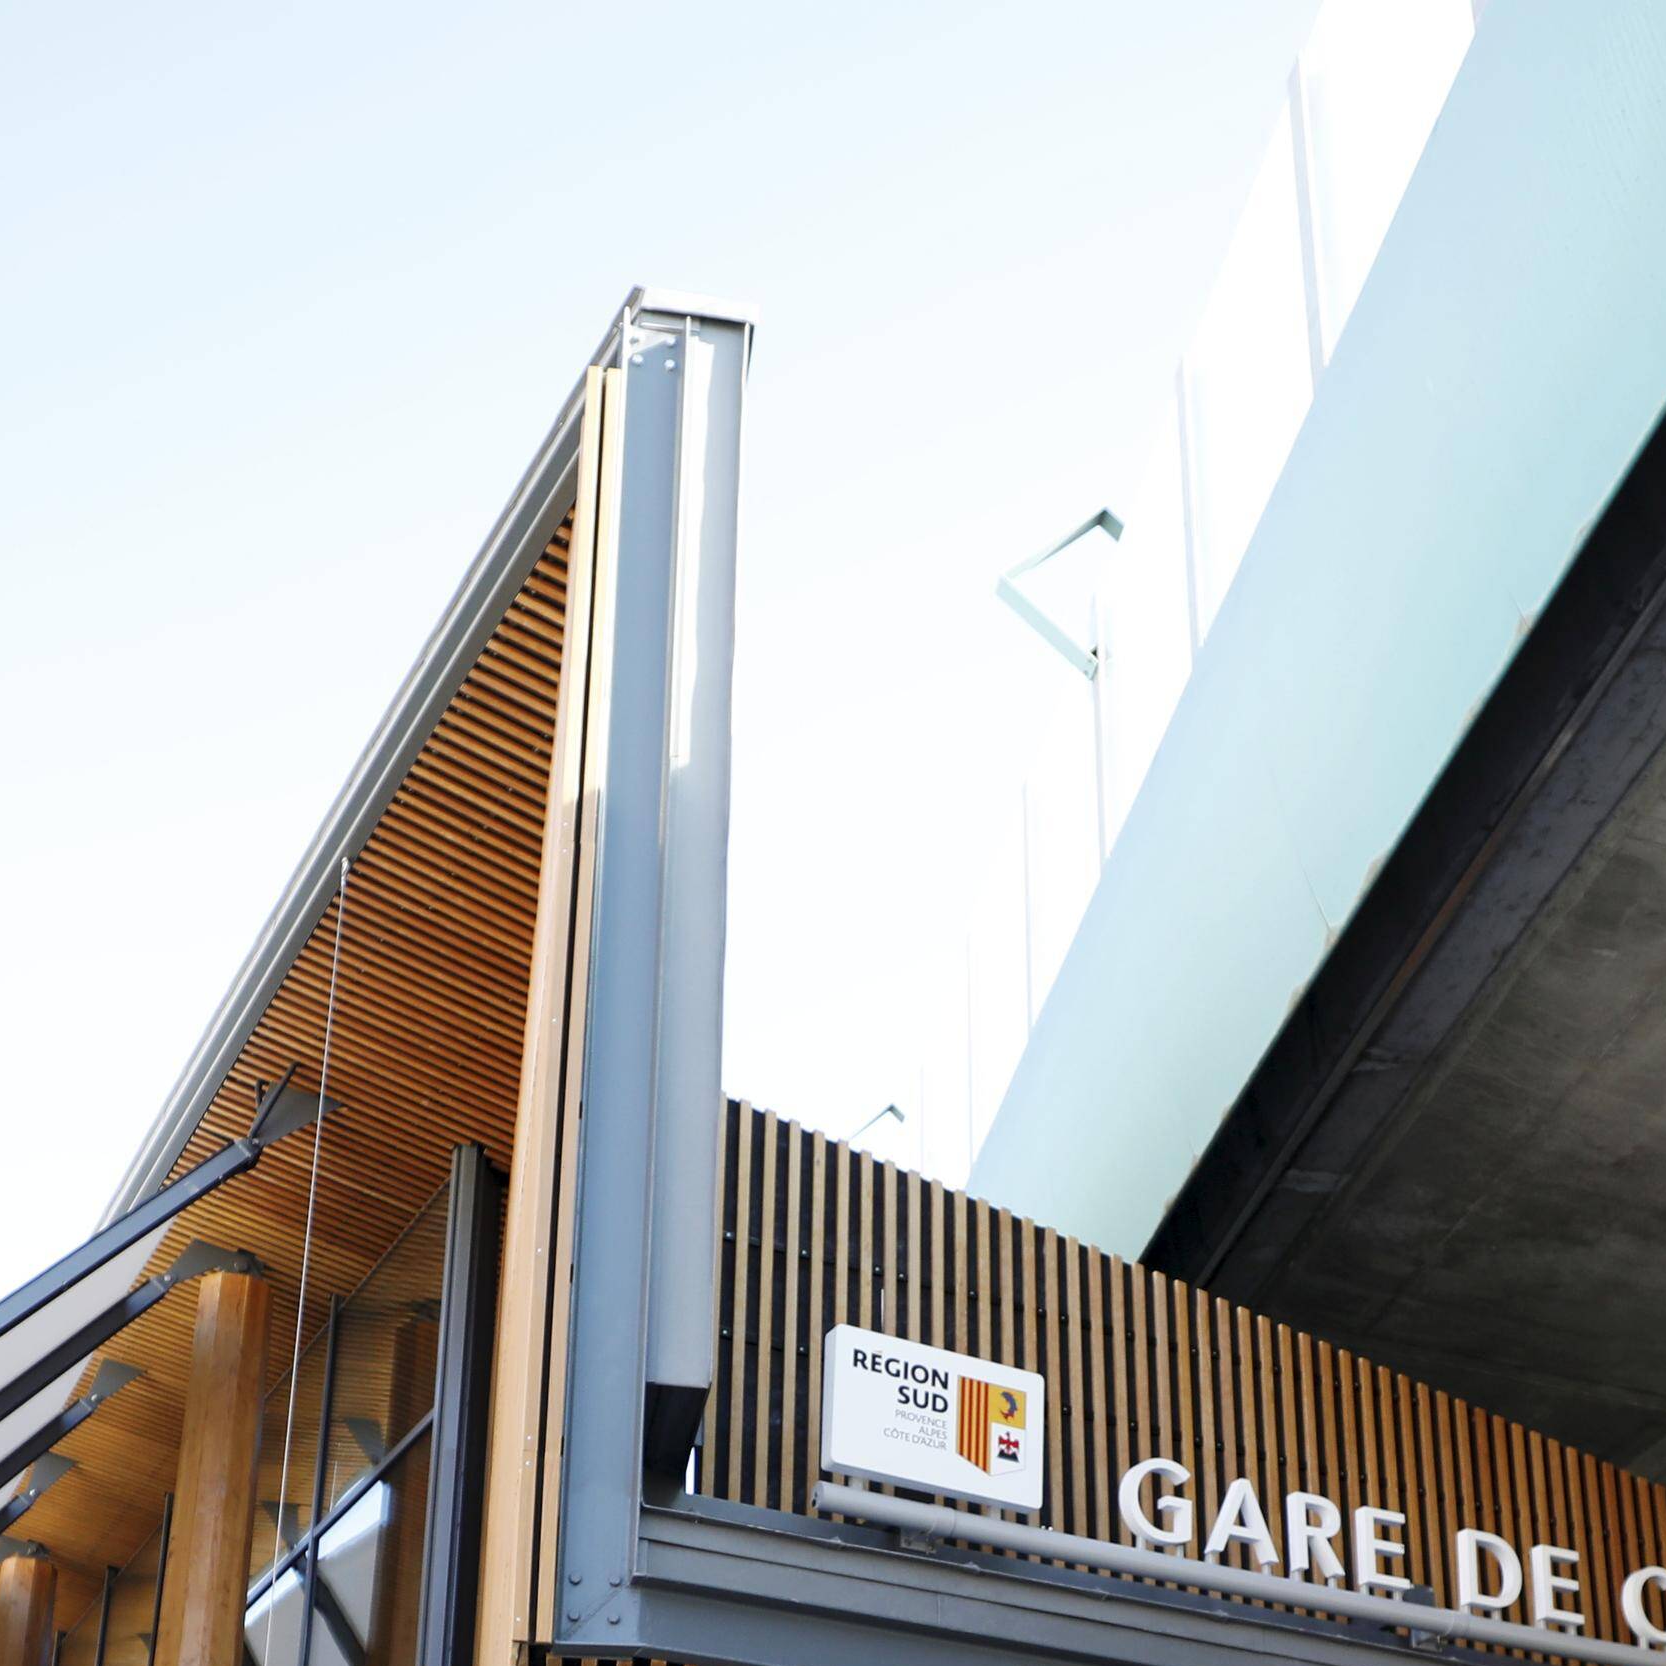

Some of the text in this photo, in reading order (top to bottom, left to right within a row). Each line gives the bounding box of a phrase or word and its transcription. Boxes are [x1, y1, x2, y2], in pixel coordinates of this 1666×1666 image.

[852, 1347, 950, 1391] RÉGION
[896, 1385, 950, 1415] SUD
[894, 1408, 948, 1430] PROVENCE
[882, 1426, 948, 1451] CÔTE D'AZUR
[918, 1425, 948, 1441] ALPES
[1118, 1456, 1412, 1591] GARE
[1456, 1527, 1586, 1627] DE
